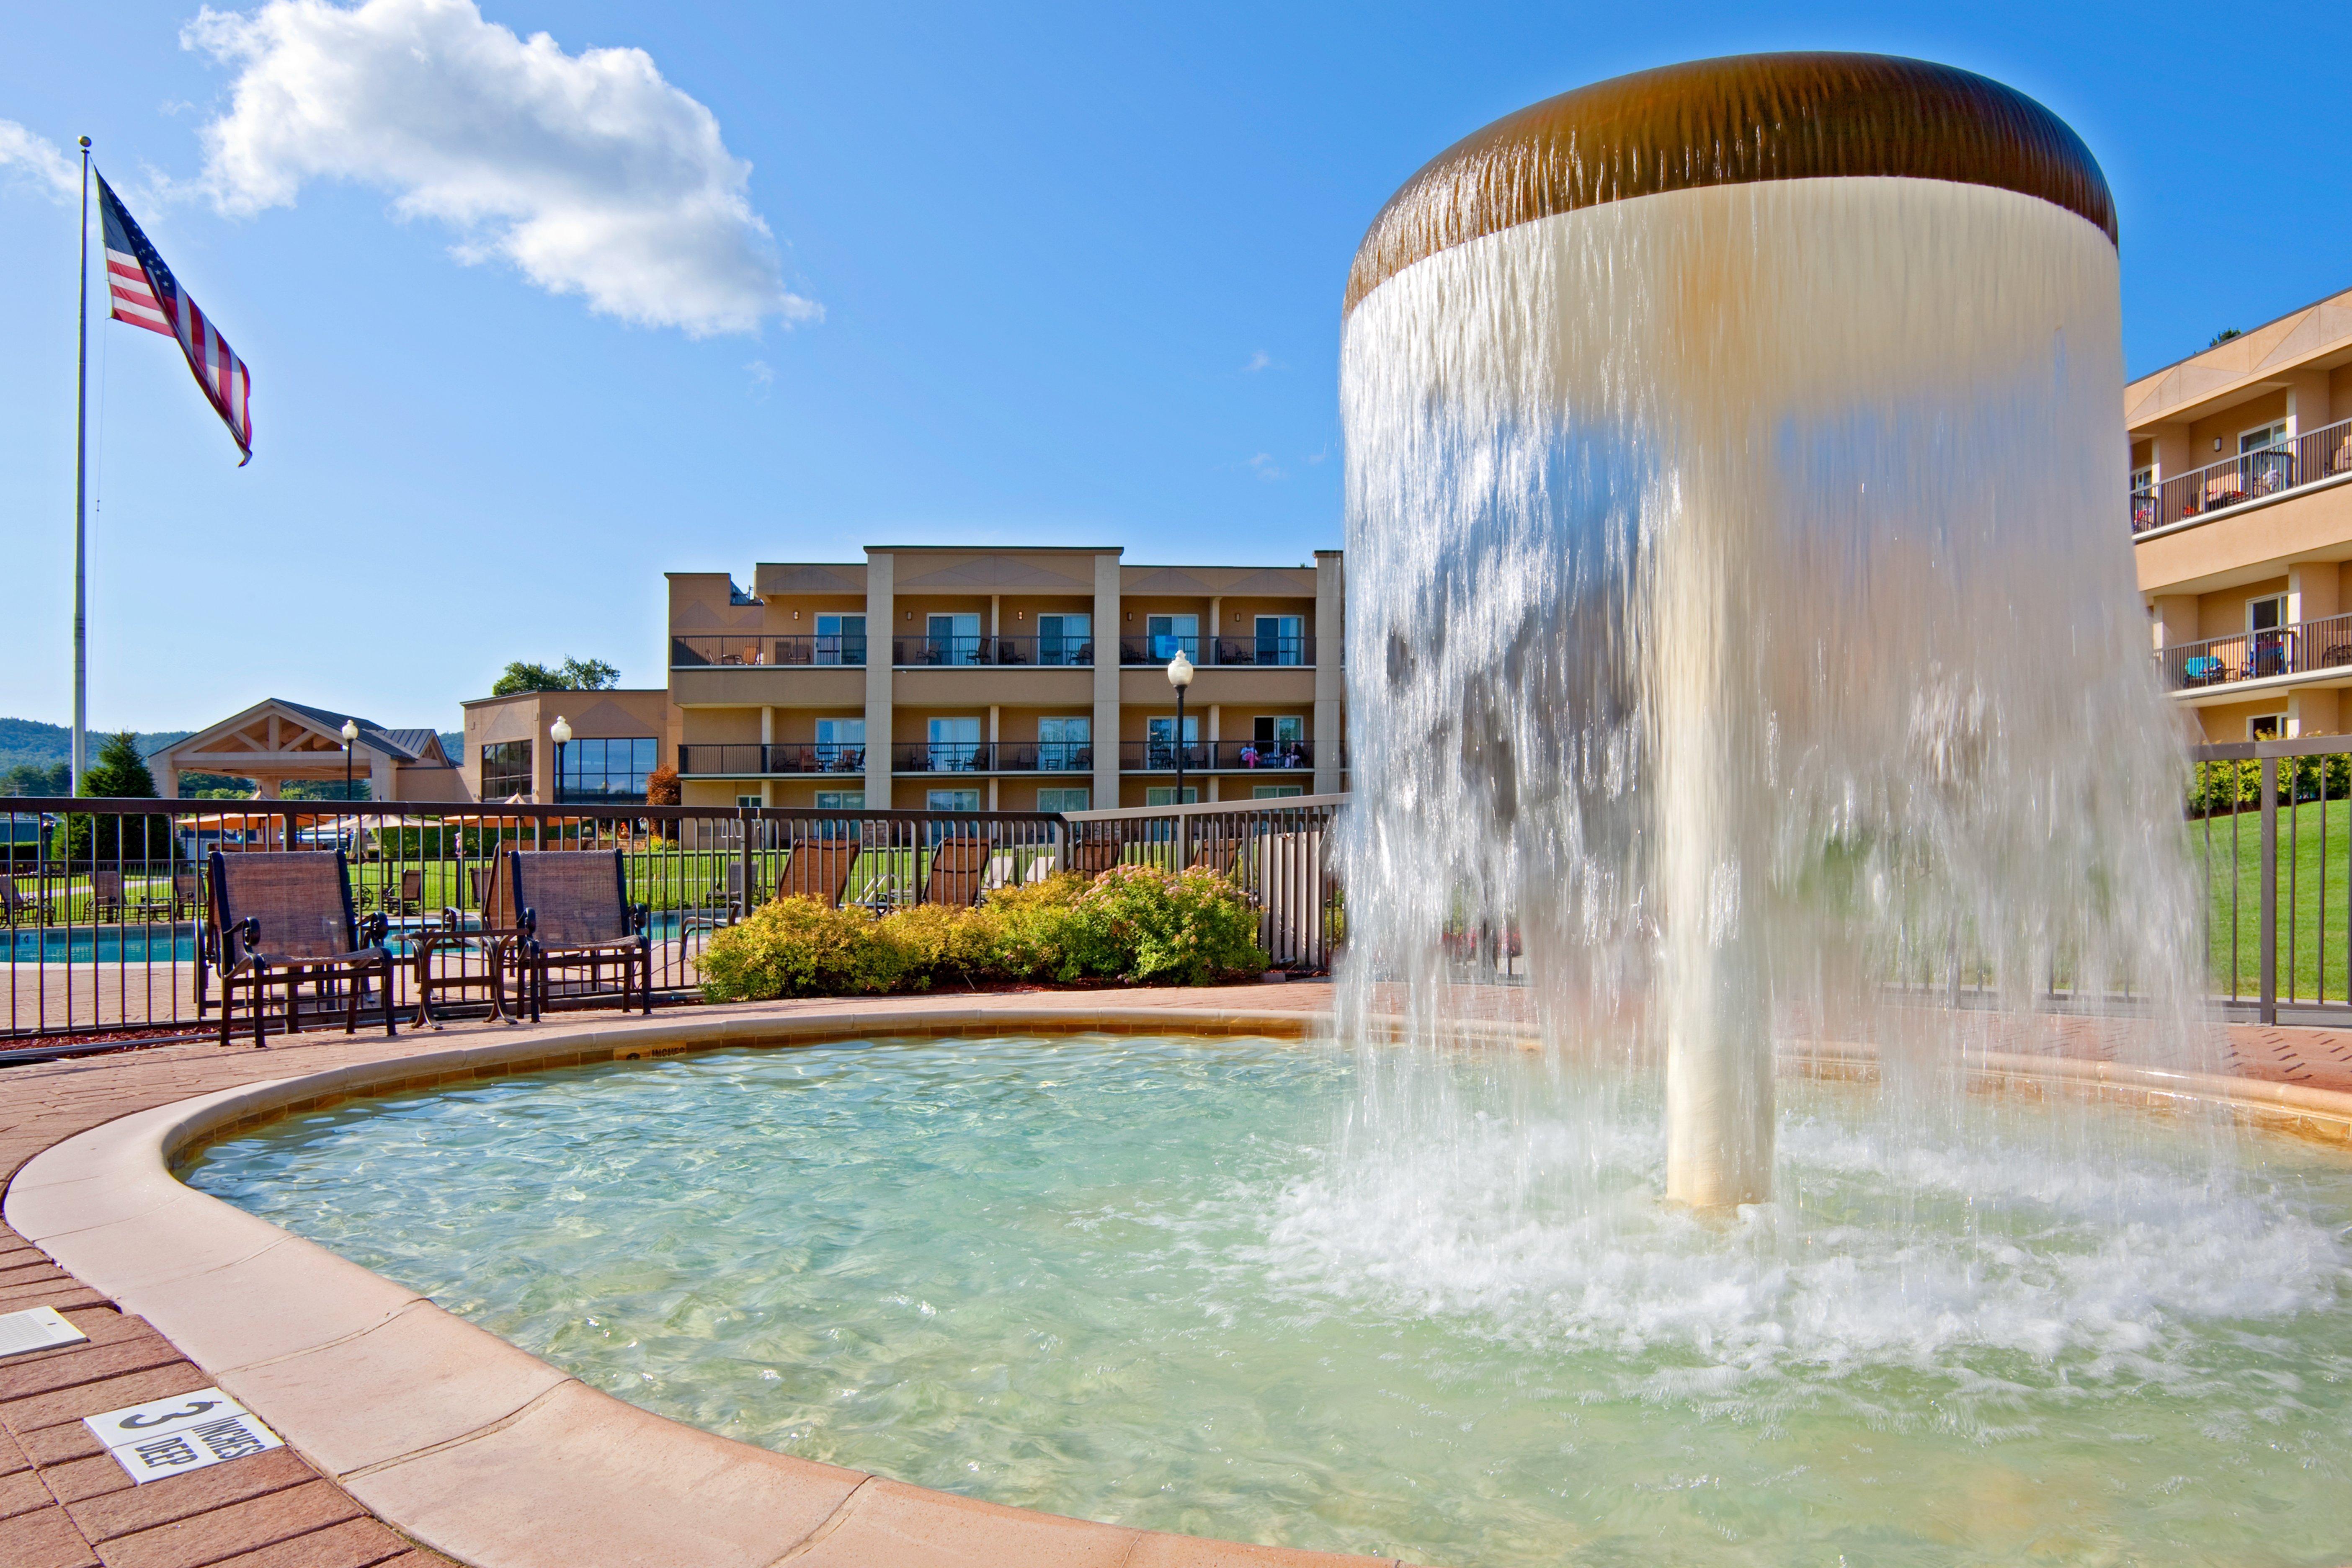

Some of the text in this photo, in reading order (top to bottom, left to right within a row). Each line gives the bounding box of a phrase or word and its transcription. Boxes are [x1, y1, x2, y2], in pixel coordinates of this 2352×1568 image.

[119, 1401, 215, 1429] 3
[134, 1437, 199, 1468] DEEP
[192, 1418, 266, 1460] INCHES
